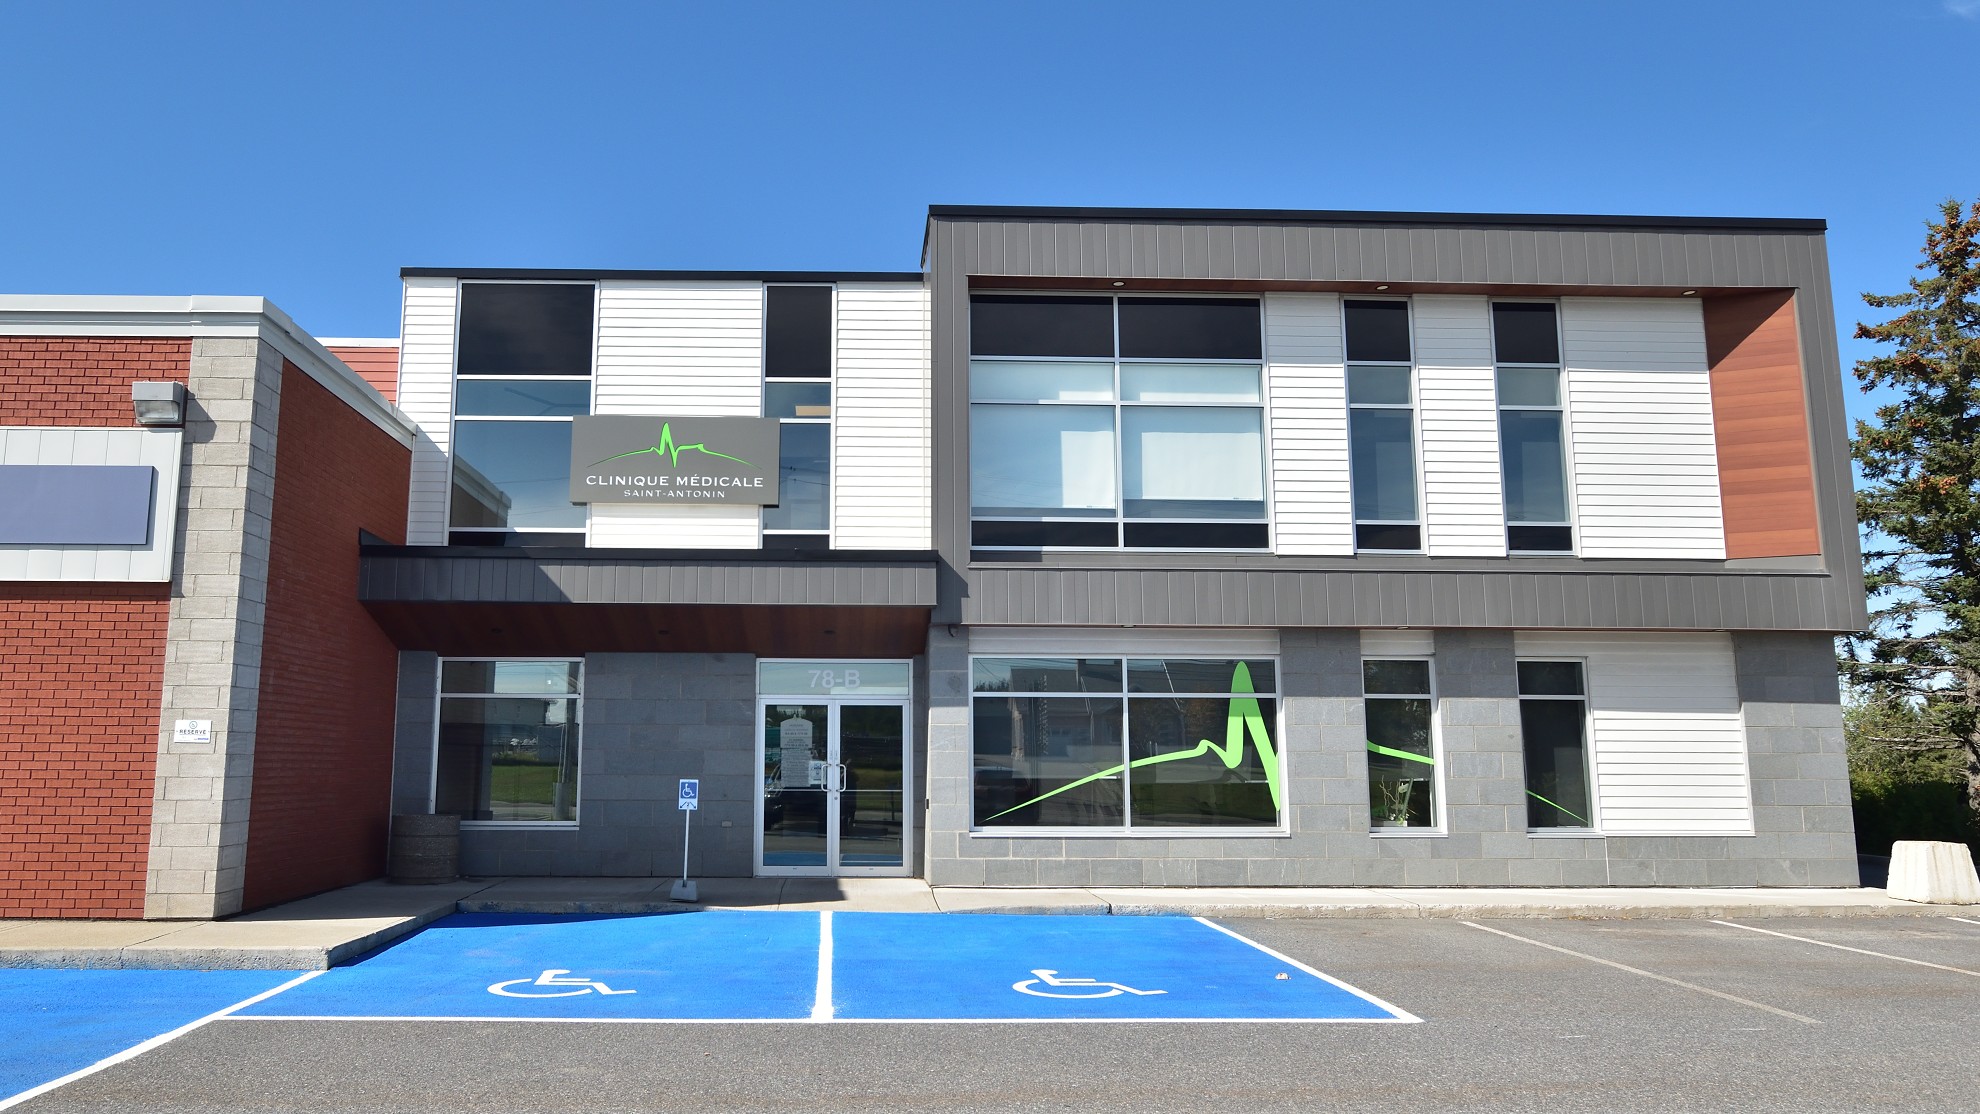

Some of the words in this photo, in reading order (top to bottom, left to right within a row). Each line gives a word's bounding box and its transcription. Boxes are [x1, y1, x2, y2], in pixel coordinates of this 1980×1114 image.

[586, 475, 669, 487] CLINIQUE
[676, 474, 764, 487] MÉDICALE
[624, 489, 726, 498] SAINT-ANTONIN
[808, 670, 861, 688] 78-B
